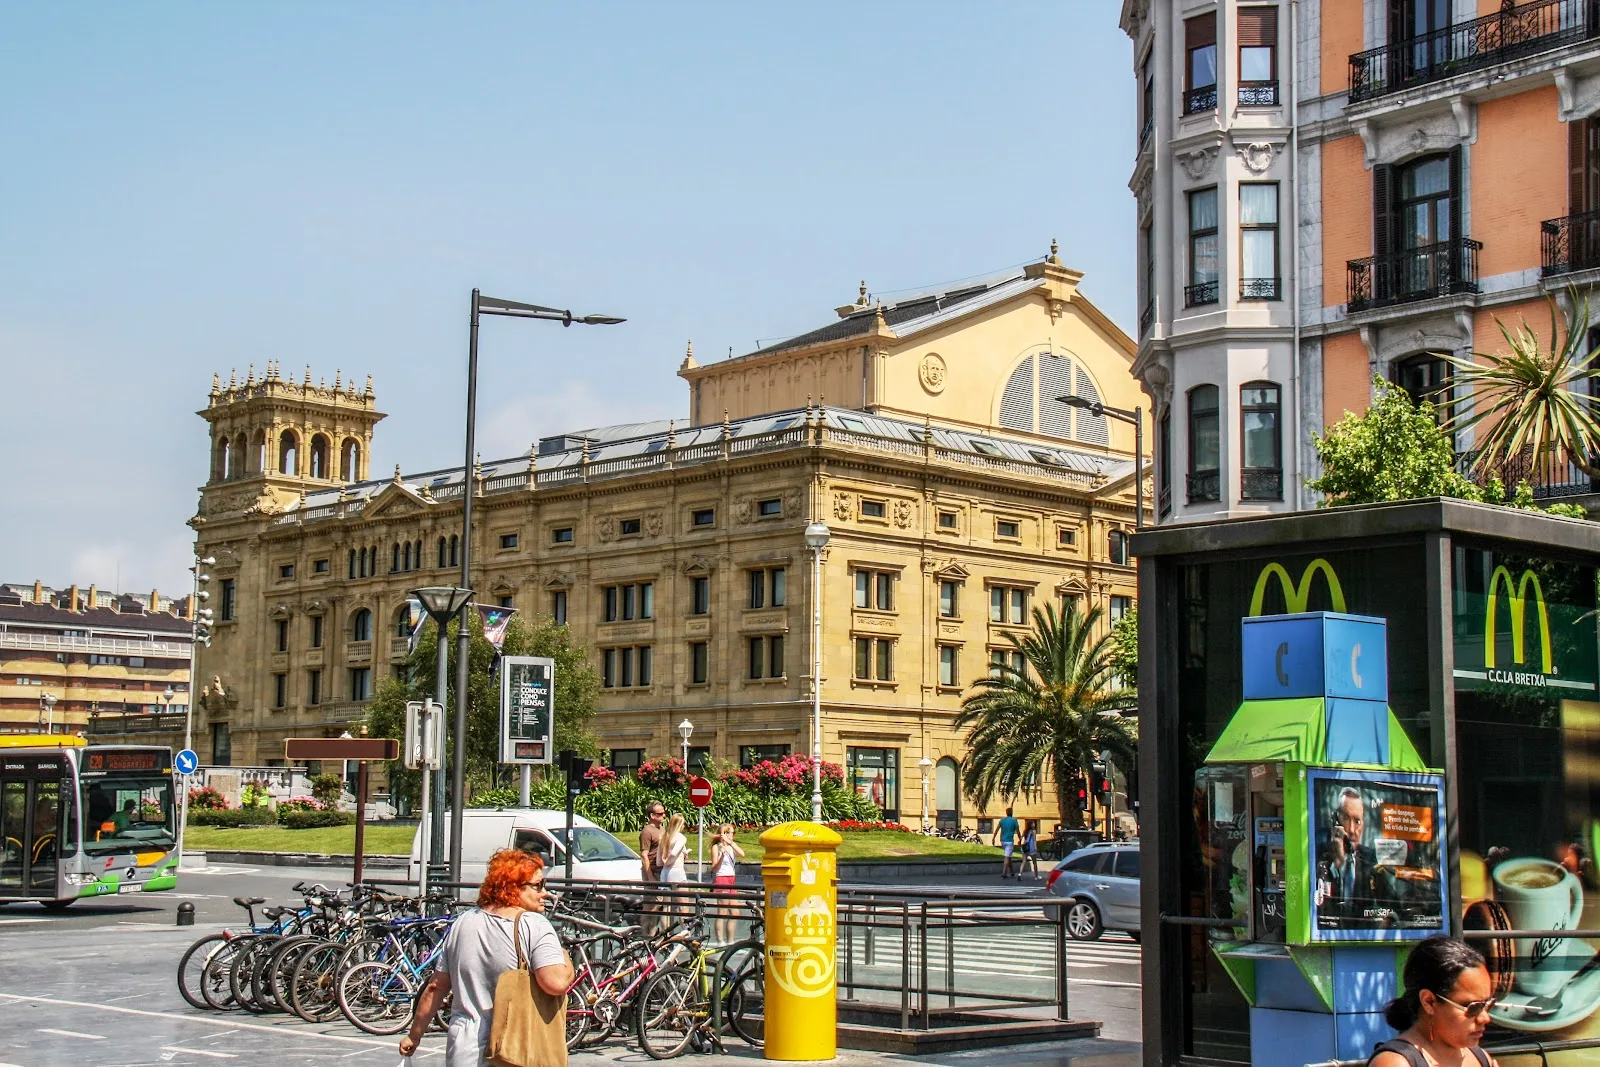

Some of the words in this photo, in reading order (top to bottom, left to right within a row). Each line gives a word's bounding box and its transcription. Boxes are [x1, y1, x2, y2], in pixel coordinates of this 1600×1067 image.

[1515, 672, 1547, 687] BRETXA
[520, 687, 548, 695] CONDUCE
[520, 699, 545, 707] PIENSAS
[89, 755, 103, 769] E20
